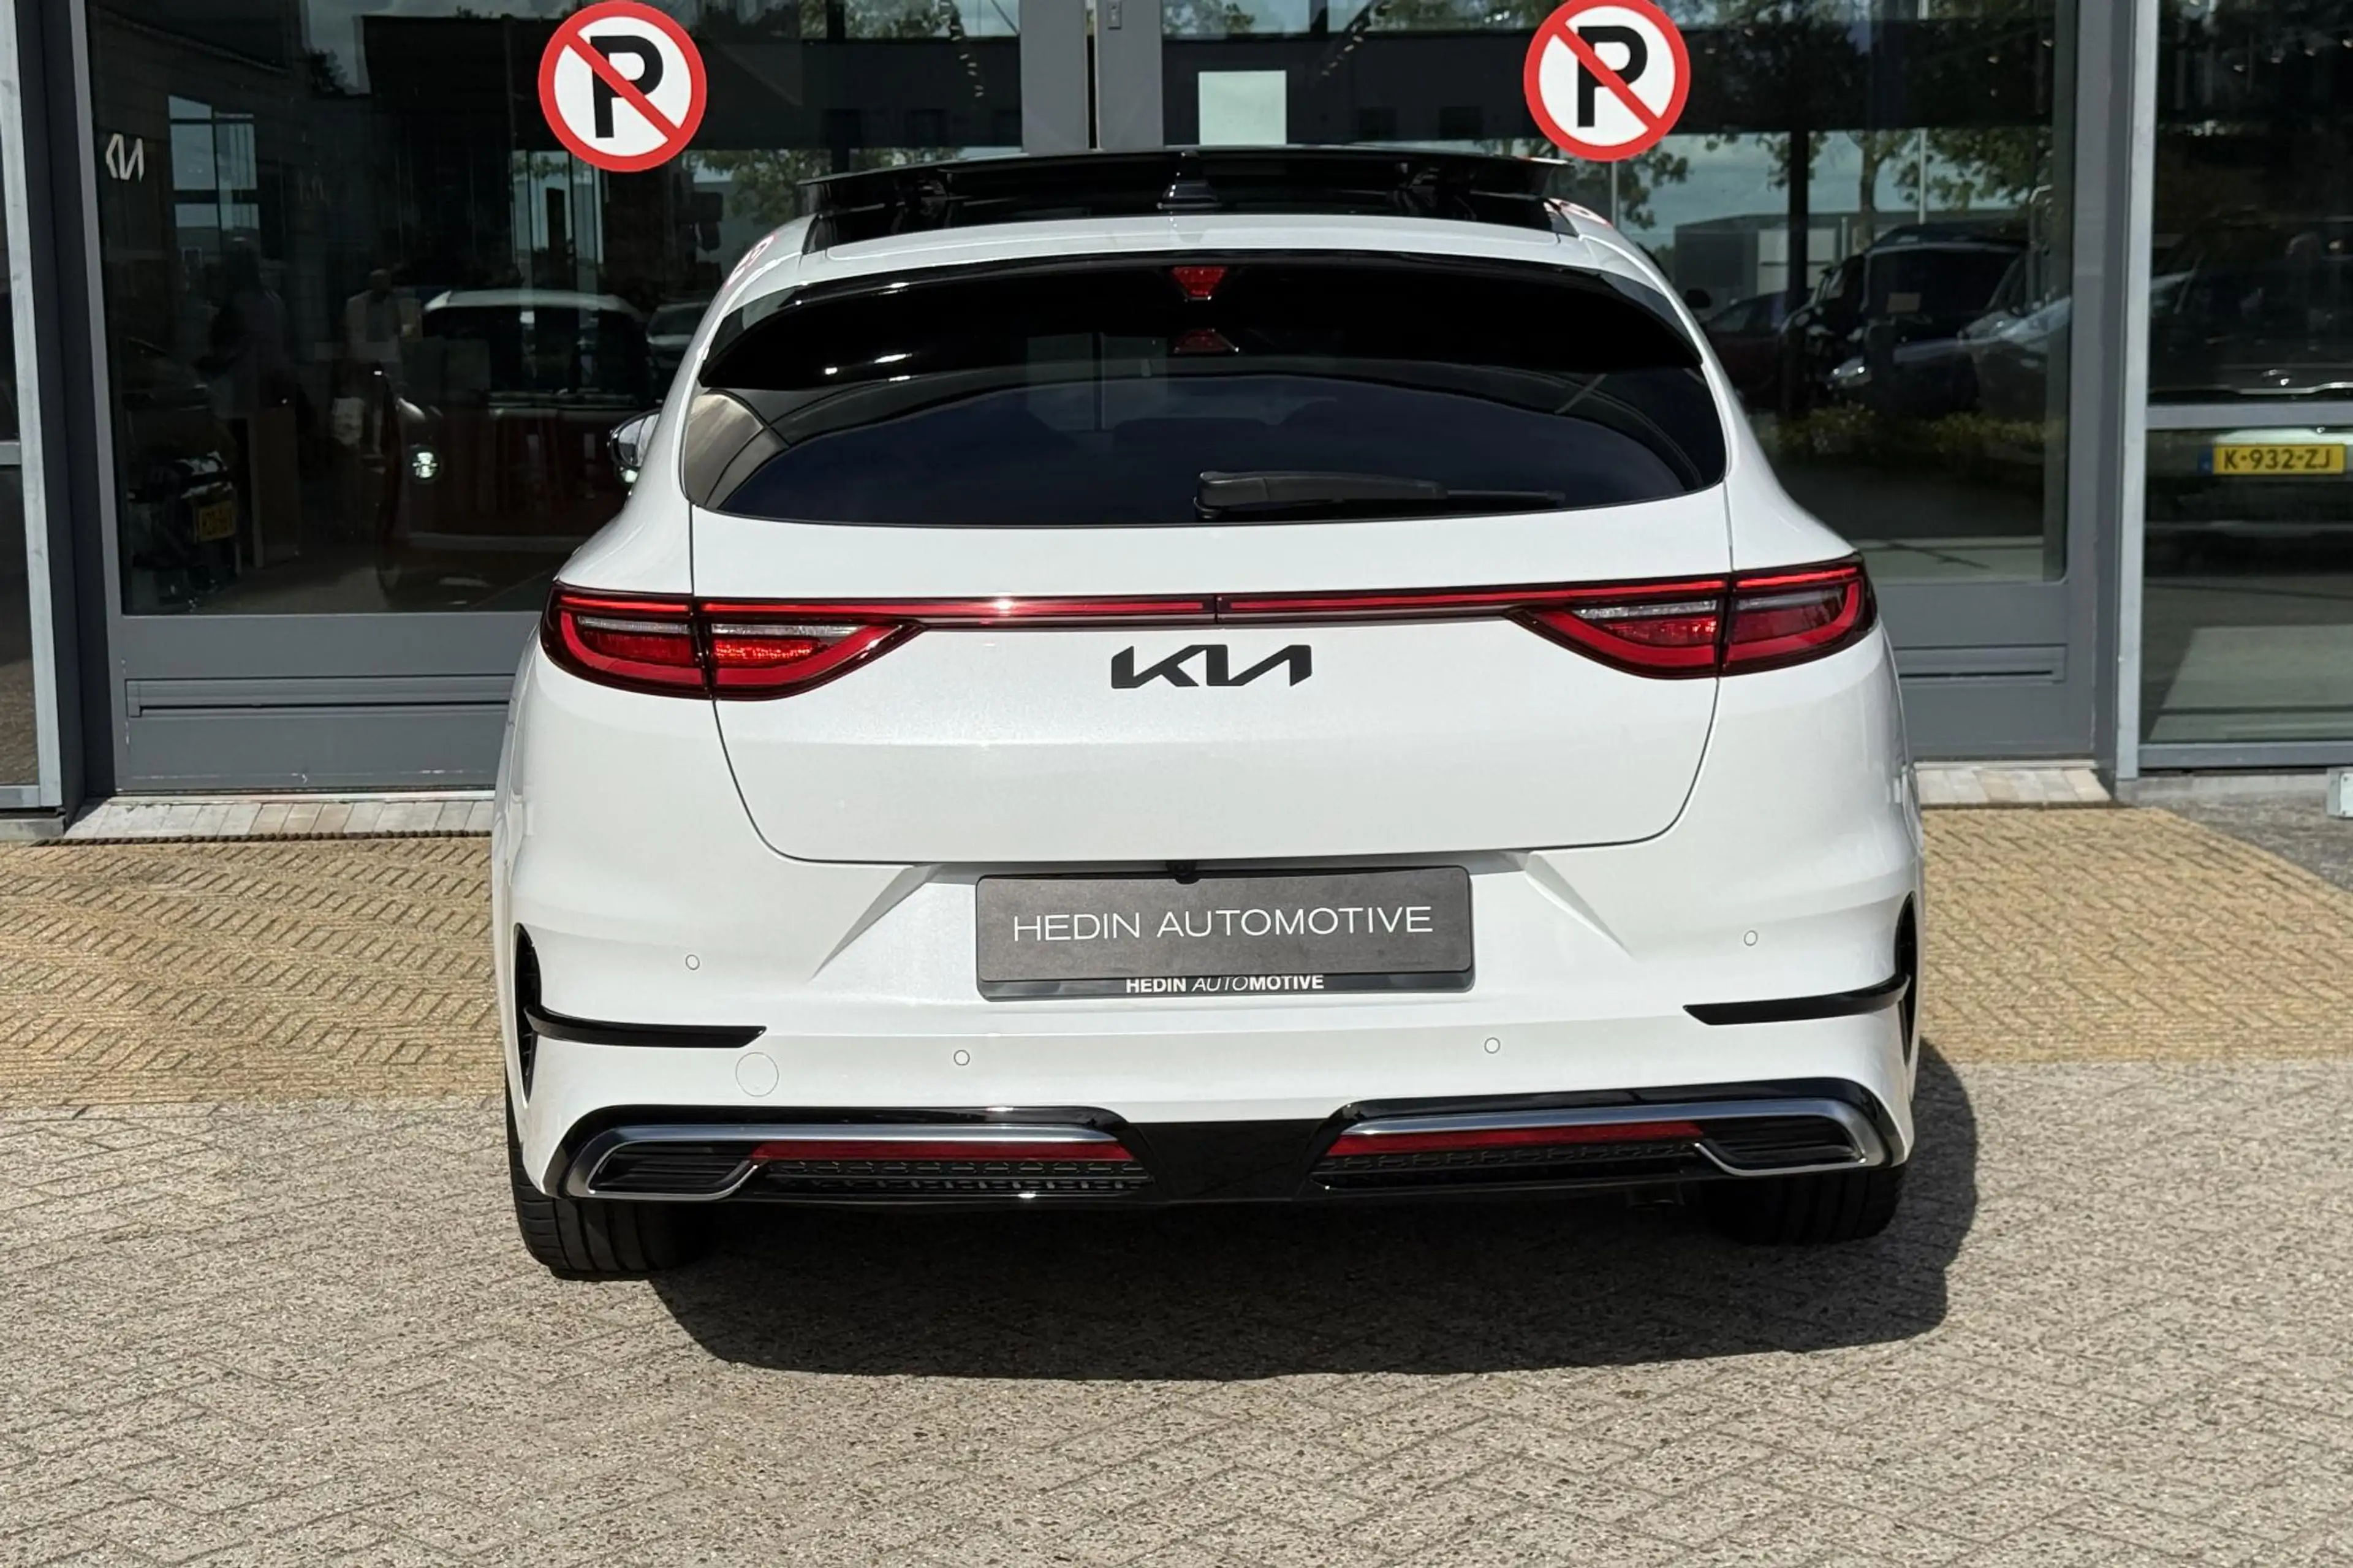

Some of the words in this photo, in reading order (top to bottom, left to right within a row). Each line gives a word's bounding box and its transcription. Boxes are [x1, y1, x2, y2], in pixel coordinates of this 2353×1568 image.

[590, 35, 664, 139] P
[1577, 25, 1648, 129] P
[2223, 448, 2331, 471] K-932-ZJ
[1111, 644, 1313, 689] KIA
[1014, 912, 1140, 942] HEDIN
[1156, 906, 1433, 938] AUTOMOTIVE
[1126, 977, 1186, 993] HEDIN
[1191, 974, 1325, 992] AUTOMOTIVE
